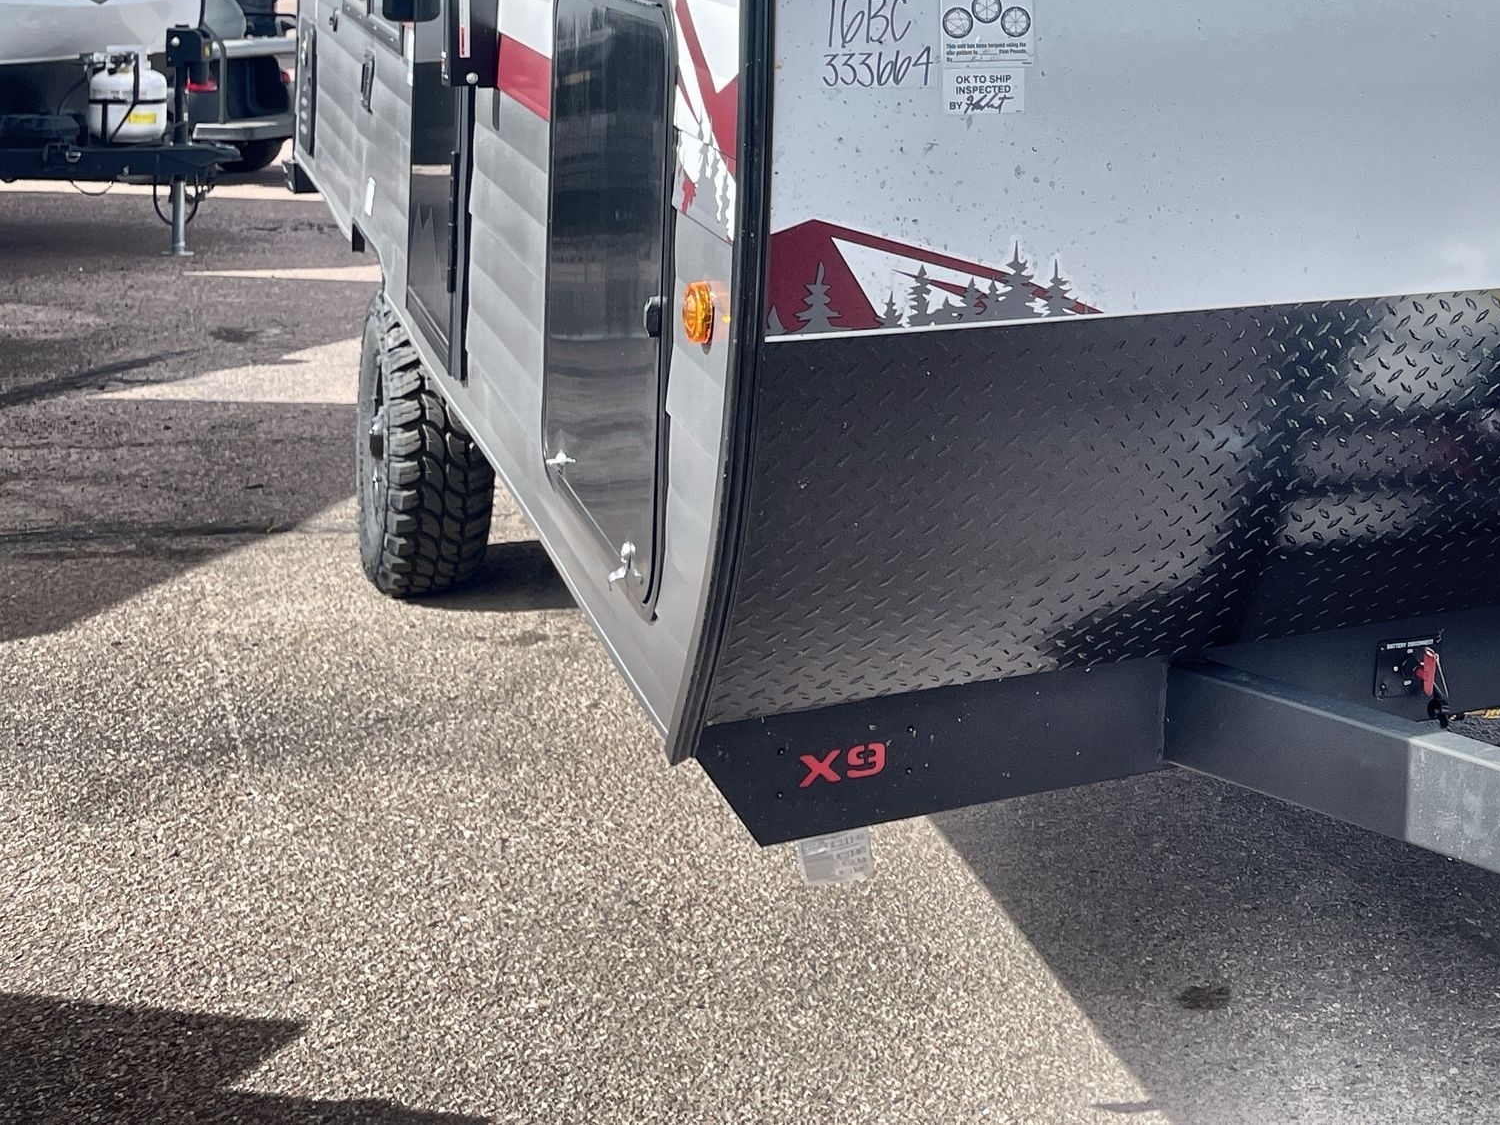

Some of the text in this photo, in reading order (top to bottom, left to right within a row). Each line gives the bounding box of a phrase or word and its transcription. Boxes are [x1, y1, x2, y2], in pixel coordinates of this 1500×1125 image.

[823, 45, 934, 87] 333664
[955, 74, 1012, 84] OK TO SHIP
[955, 84, 1011, 95] INSPECTED
[949, 101, 963, 110] BY
[800, 742, 887, 789] X9
